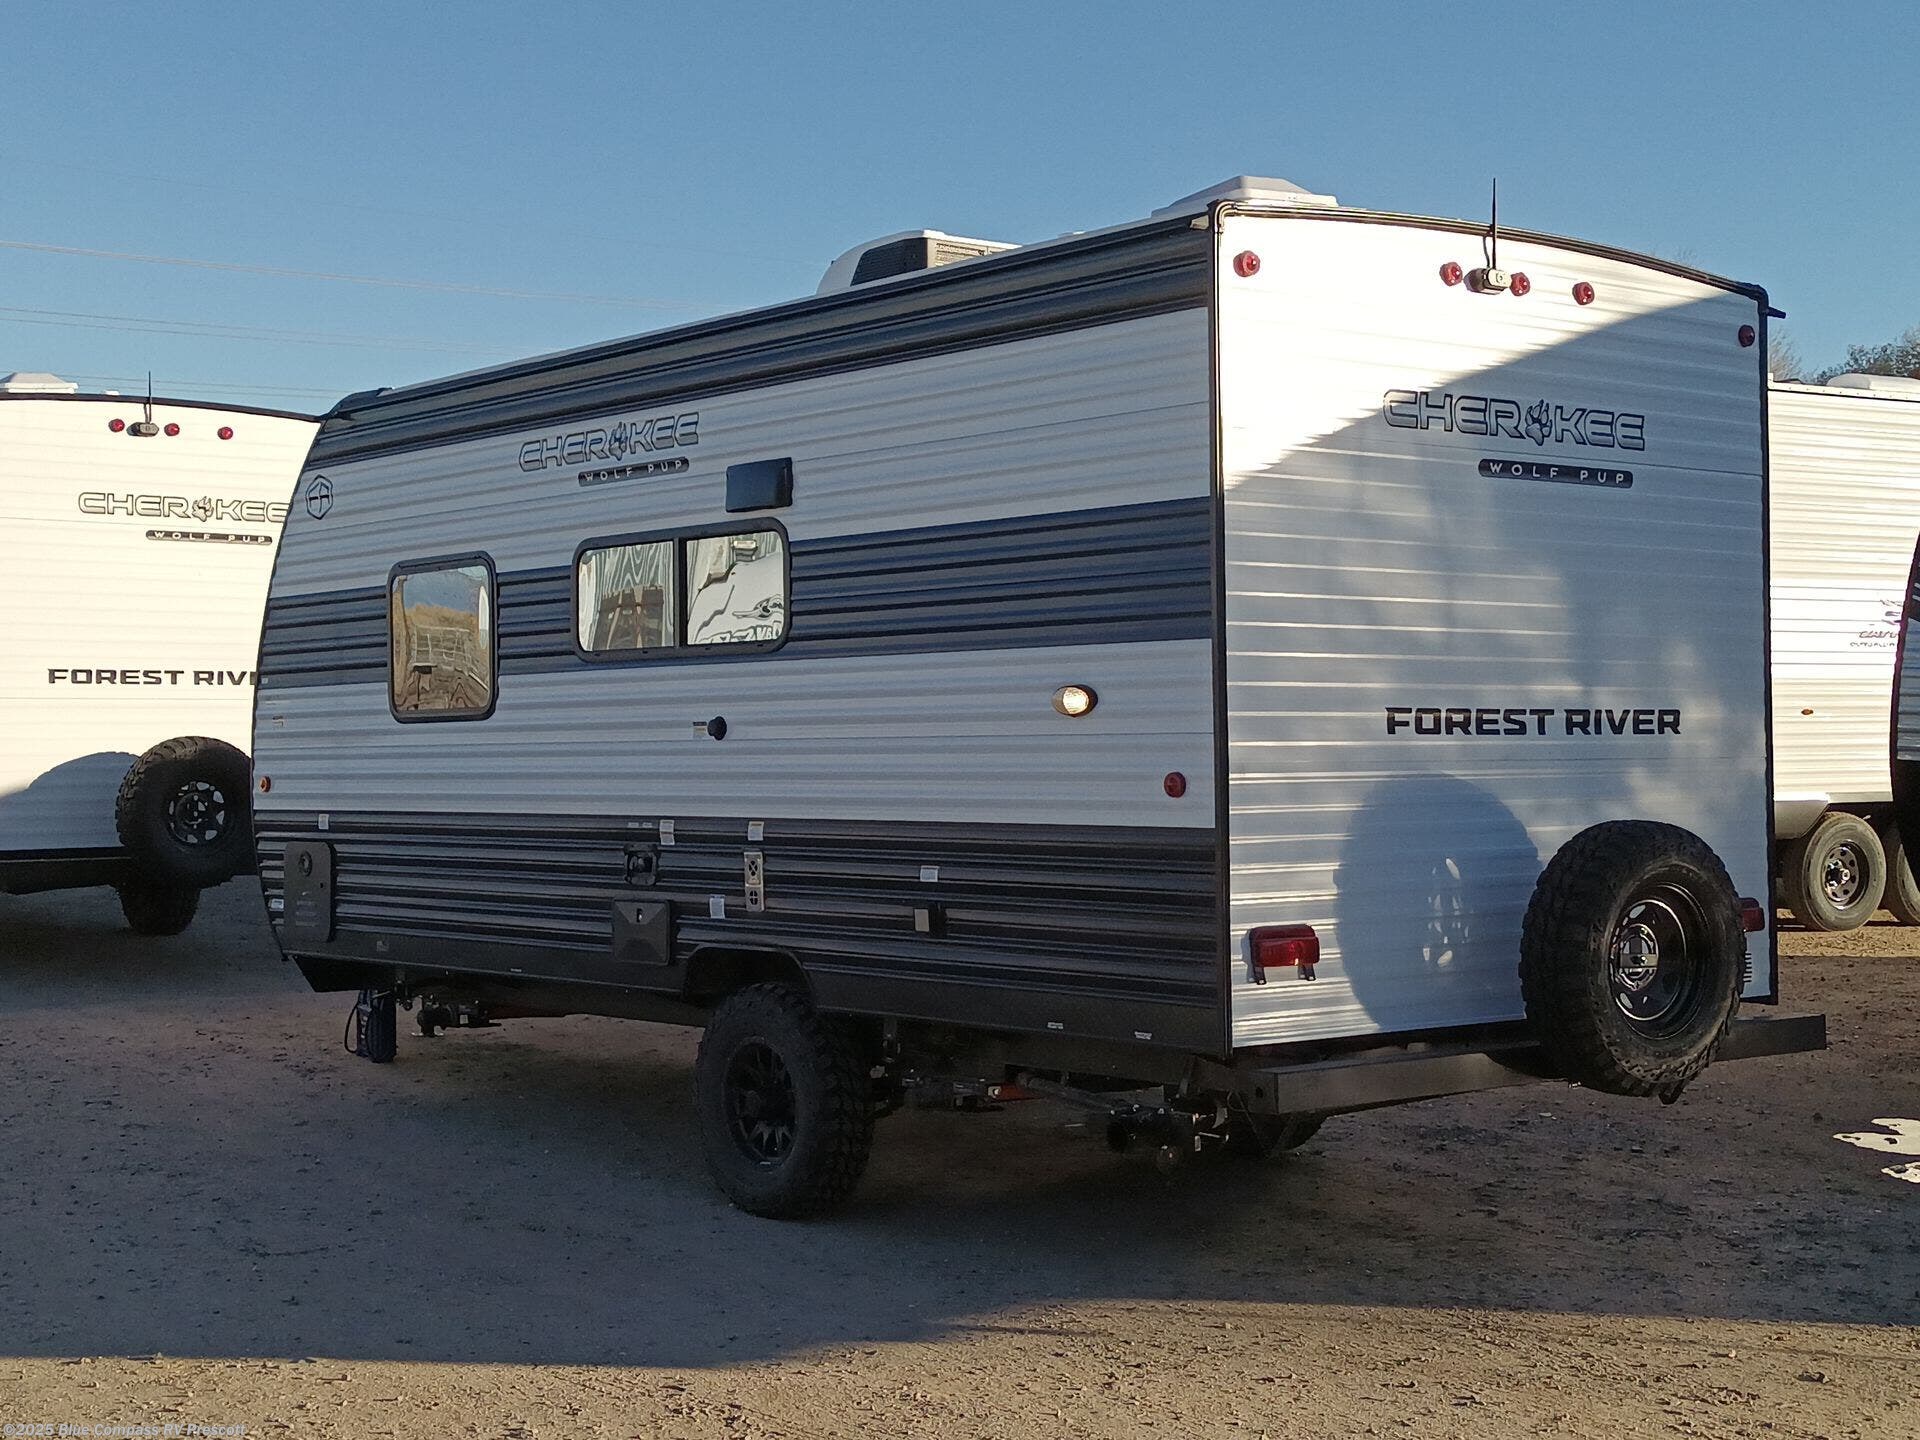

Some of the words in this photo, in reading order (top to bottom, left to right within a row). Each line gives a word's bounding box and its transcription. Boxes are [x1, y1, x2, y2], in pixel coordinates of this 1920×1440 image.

[585, 467, 632, 482] WOLF
[647, 460, 682, 474] PUP
[1489, 462, 1559, 479] WOLF
[1579, 470, 1624, 484] PUP
[154, 531, 211, 541] WOLF
[227, 534, 266, 543] PUP
[47, 668, 185, 685] FOREST
[1385, 707, 1555, 736] FOREST
[1563, 708, 1682, 736] RIVER
